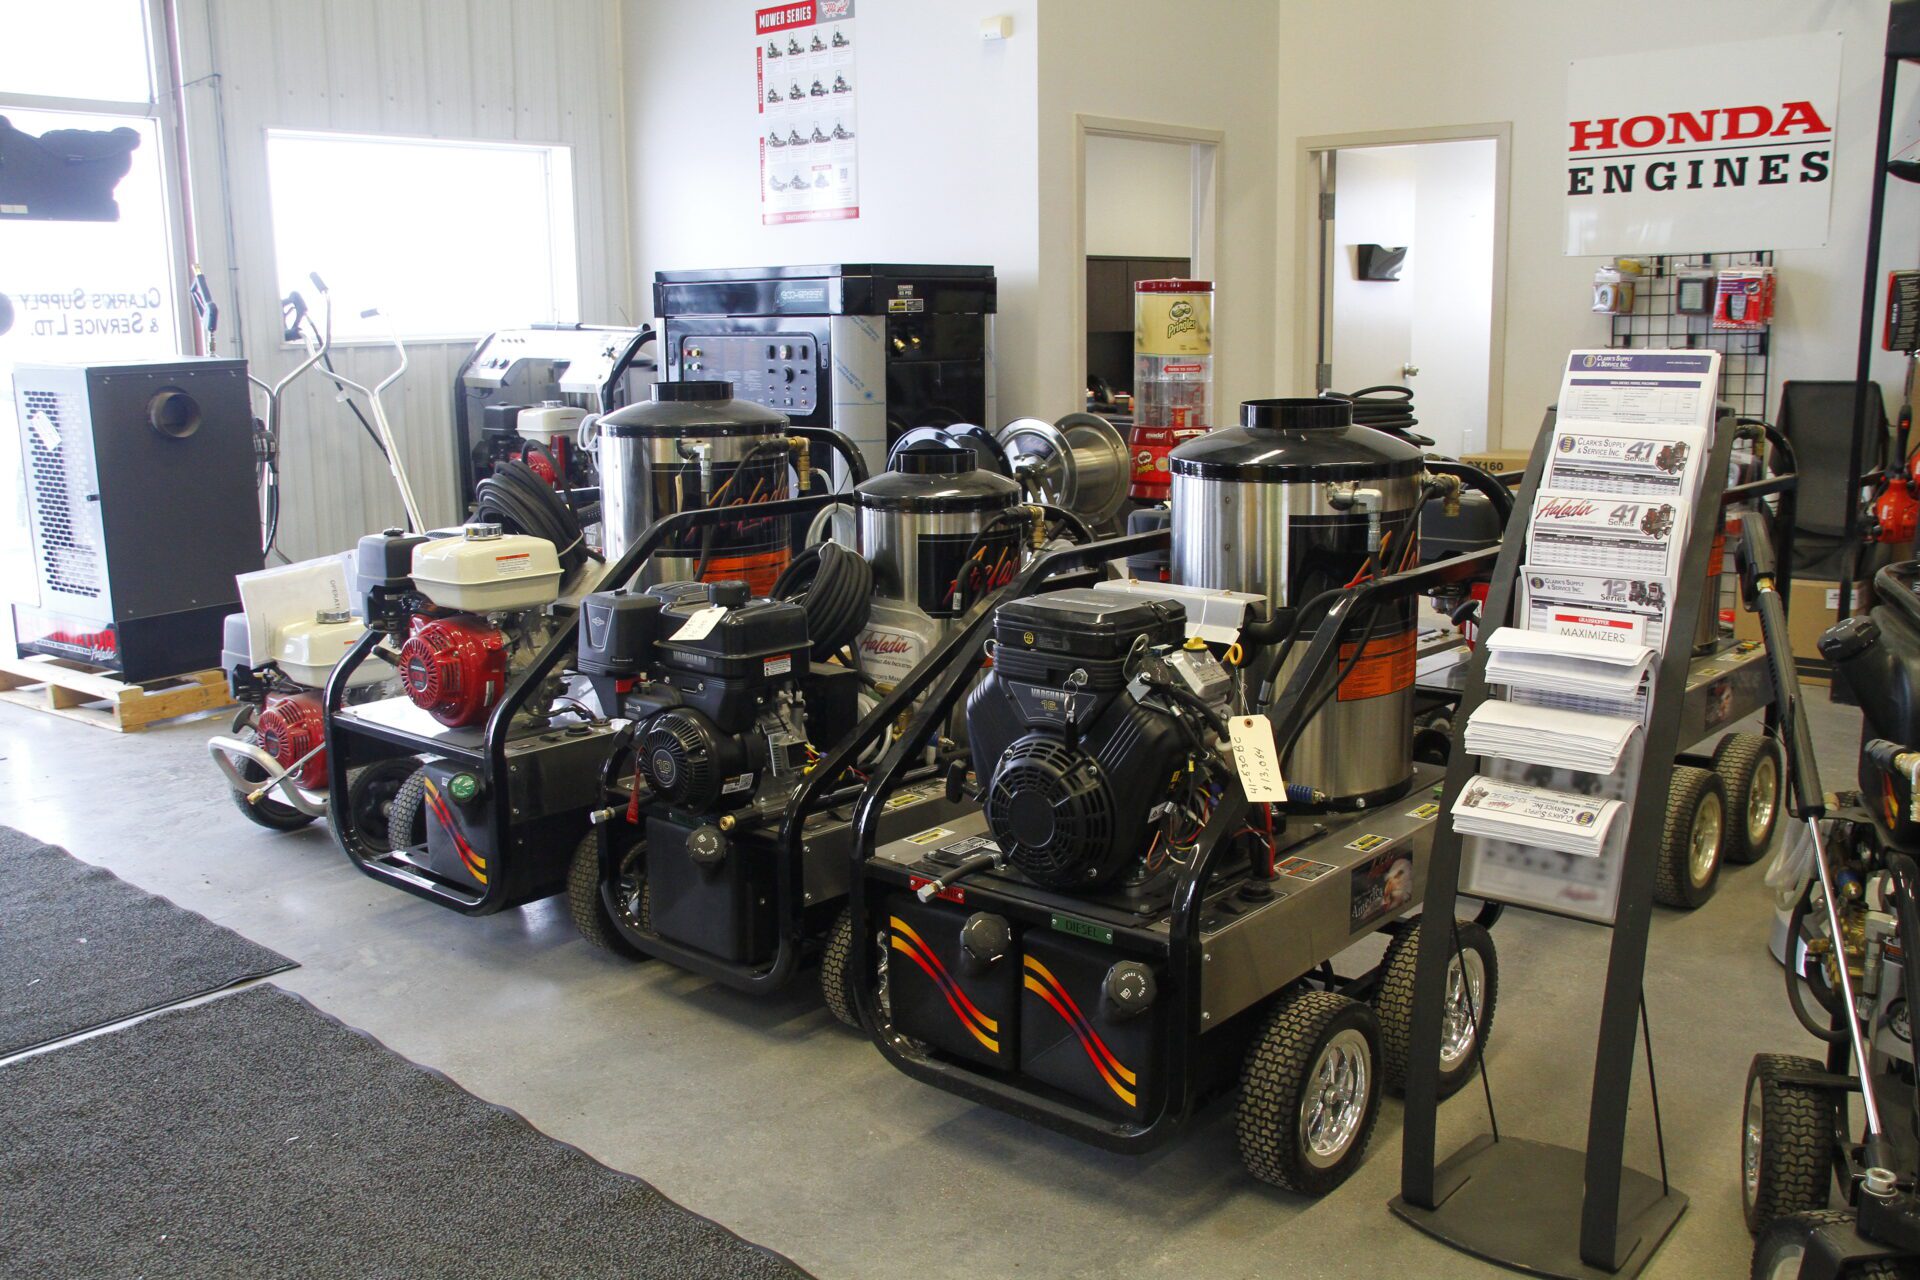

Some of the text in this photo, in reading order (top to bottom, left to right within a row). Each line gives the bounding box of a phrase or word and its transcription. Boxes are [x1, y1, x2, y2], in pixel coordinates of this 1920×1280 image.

[759, 10, 786, 29] MOWER
[786, 6, 812, 23] SERIES
[1568, 101, 1832, 152] HONDA
[1568, 151, 1830, 196] ENGINES
[1167, 317, 1196, 338] Pringles
[1578, 437, 1626, 448] CLARK'S SUPPLY
[1582, 446, 1608, 455] SERVICE
[1626, 441, 1655, 459] 41
[1610, 504, 1640, 521] 41
[1608, 518, 1634, 527] Series
[1602, 580, 1627, 597] 12
[1600, 594, 1626, 602] Series
[1560, 627, 1625, 643] MAXIMIZERS
[673, 651, 707, 666] VANGUARD
[1524, 809, 1574, 822] CLARK'S SUPPLY
[1544, 805, 1570, 814] SERVICE
[1066, 920, 1097, 937] DIESEL
